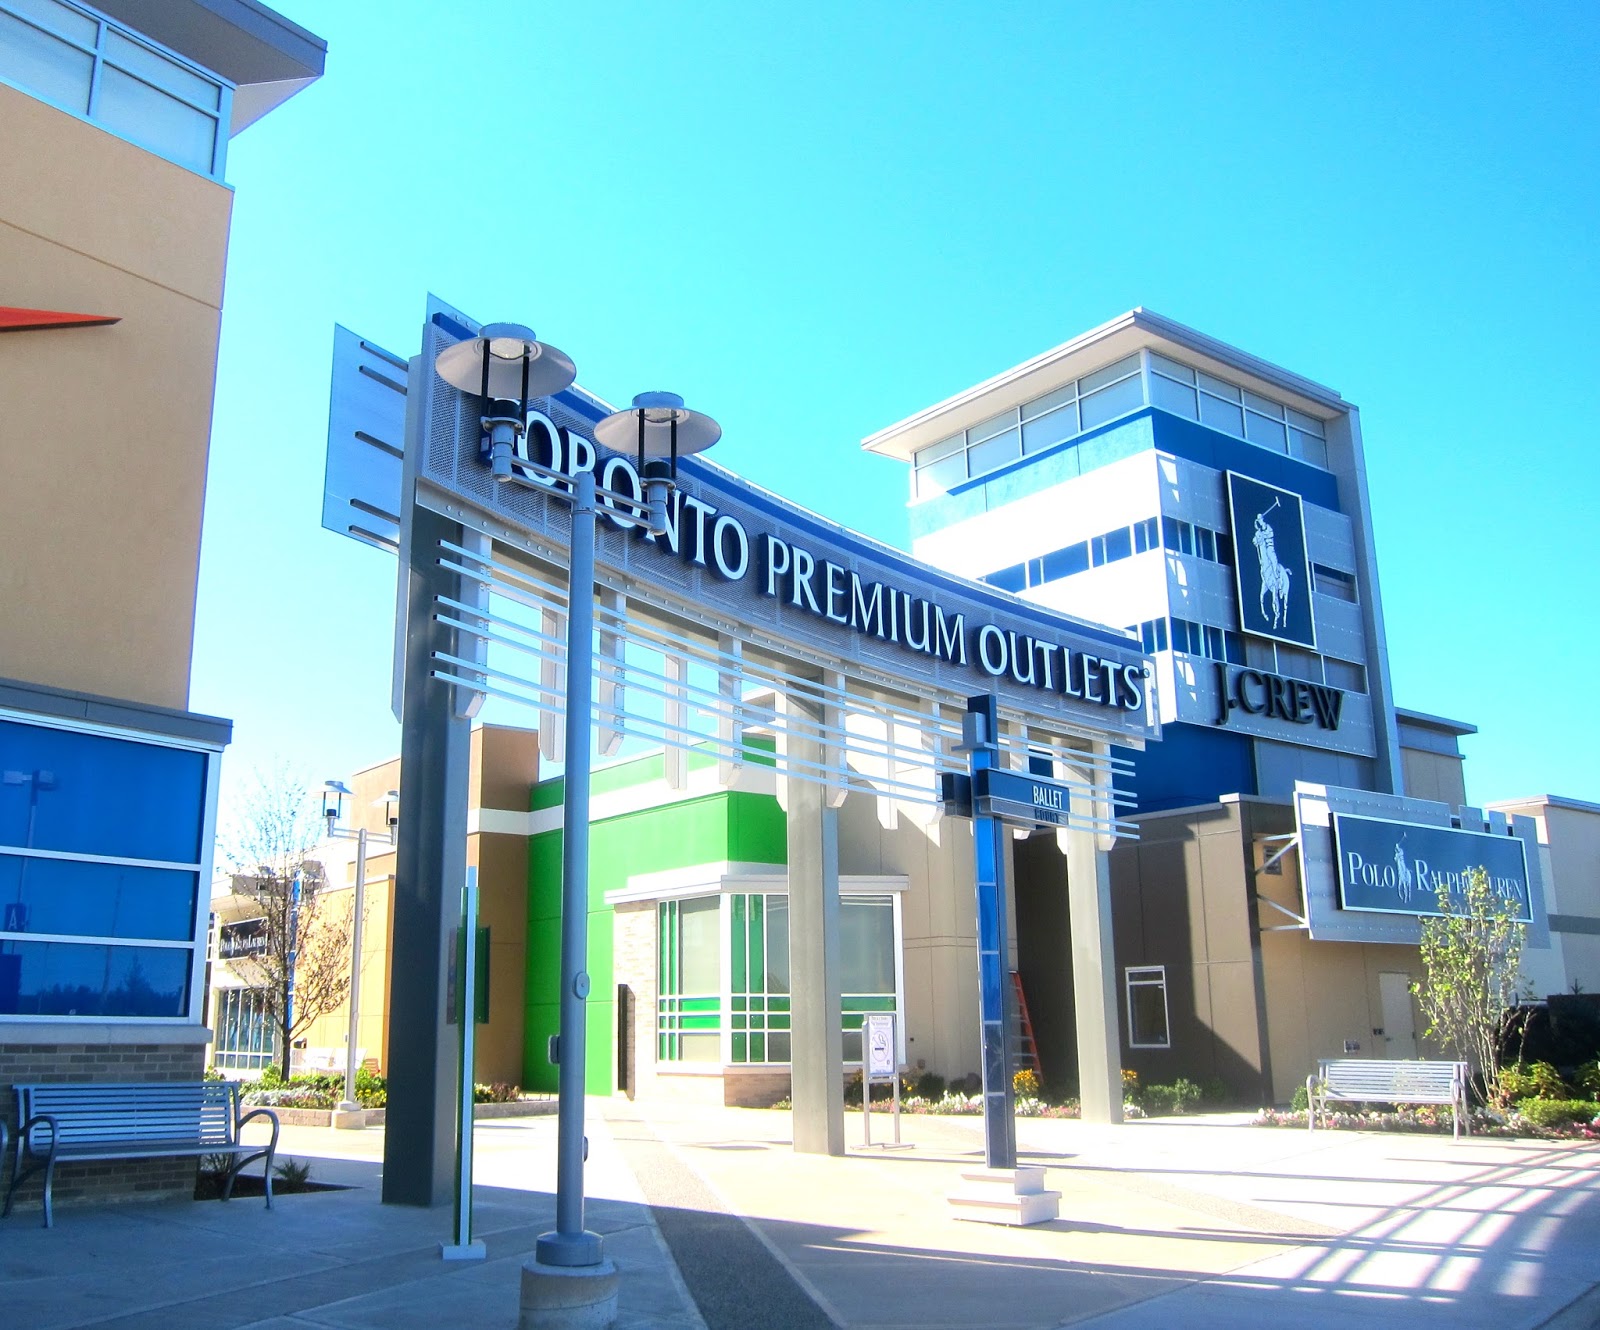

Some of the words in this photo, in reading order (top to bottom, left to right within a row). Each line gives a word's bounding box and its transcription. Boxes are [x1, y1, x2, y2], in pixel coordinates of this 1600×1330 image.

[483, 397, 749, 581] ORONTO
[764, 534, 968, 666] PREMIUM
[1033, 785, 1062, 809] BALLET
[1347, 851, 1396, 888] POLO
